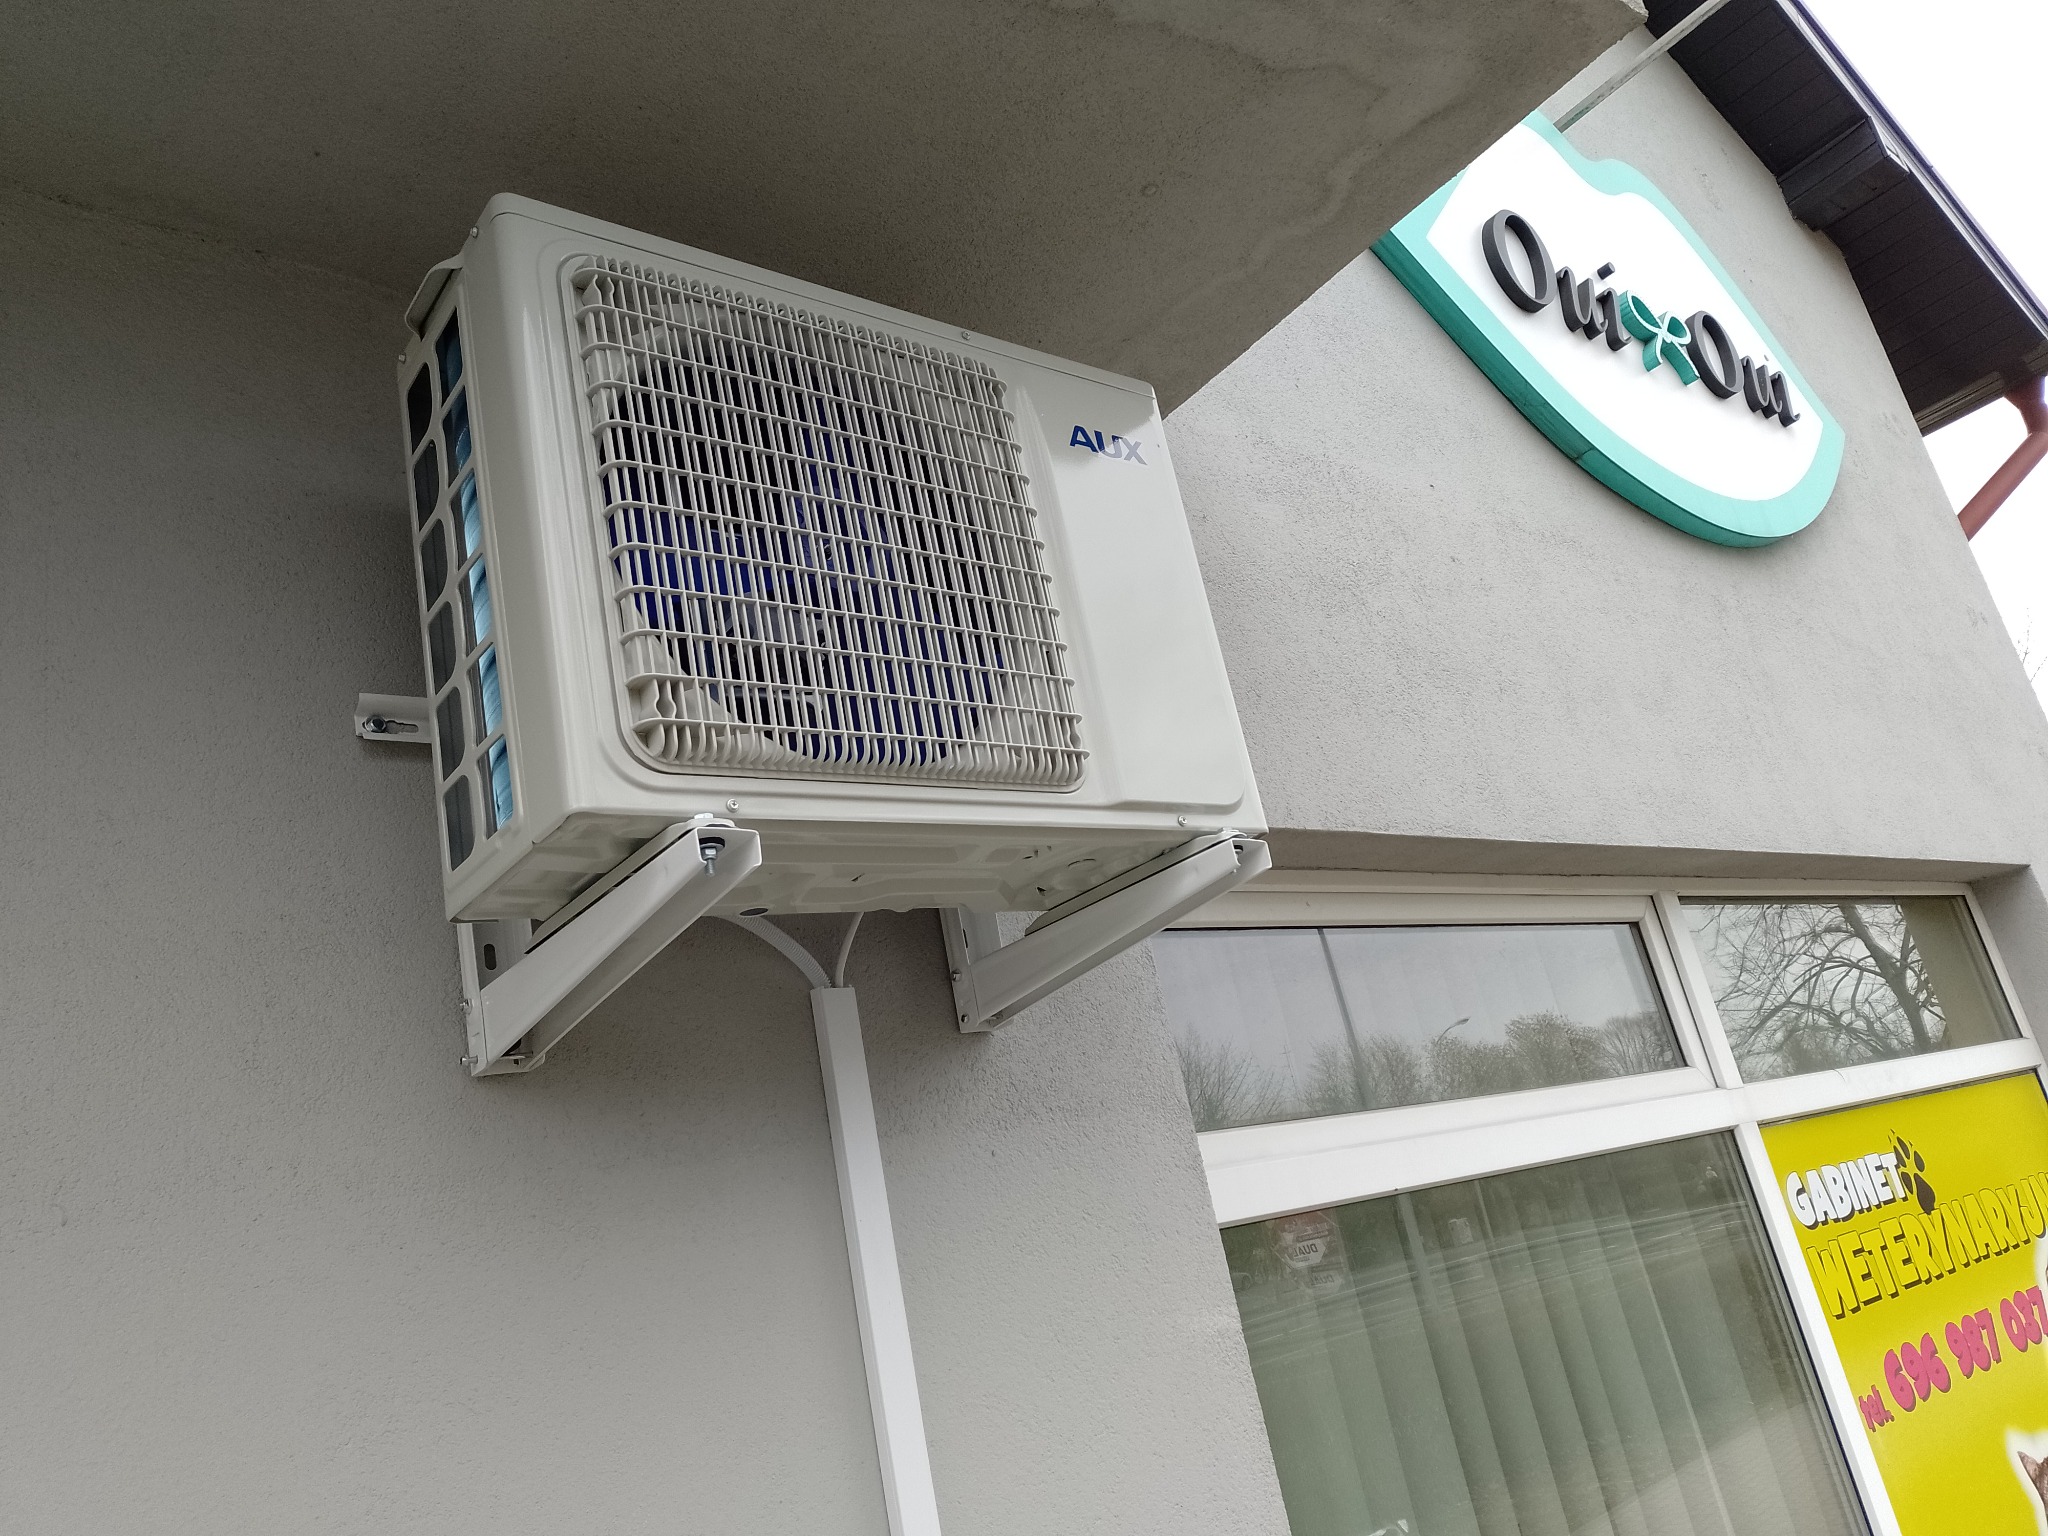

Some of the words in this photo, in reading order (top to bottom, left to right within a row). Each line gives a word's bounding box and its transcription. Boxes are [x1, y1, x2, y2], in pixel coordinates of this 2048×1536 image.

[1482, 209, 1632, 351] Oui
[1685, 310, 1800, 427] Oui
[1069, 425, 1147, 466] AUX
[1786, 1151, 1907, 1229] GABINET
[1858, 1384, 1895, 1432] tel.
[1884, 1332, 1951, 1412] 696
[1945, 1308, 2001, 1380] 987
